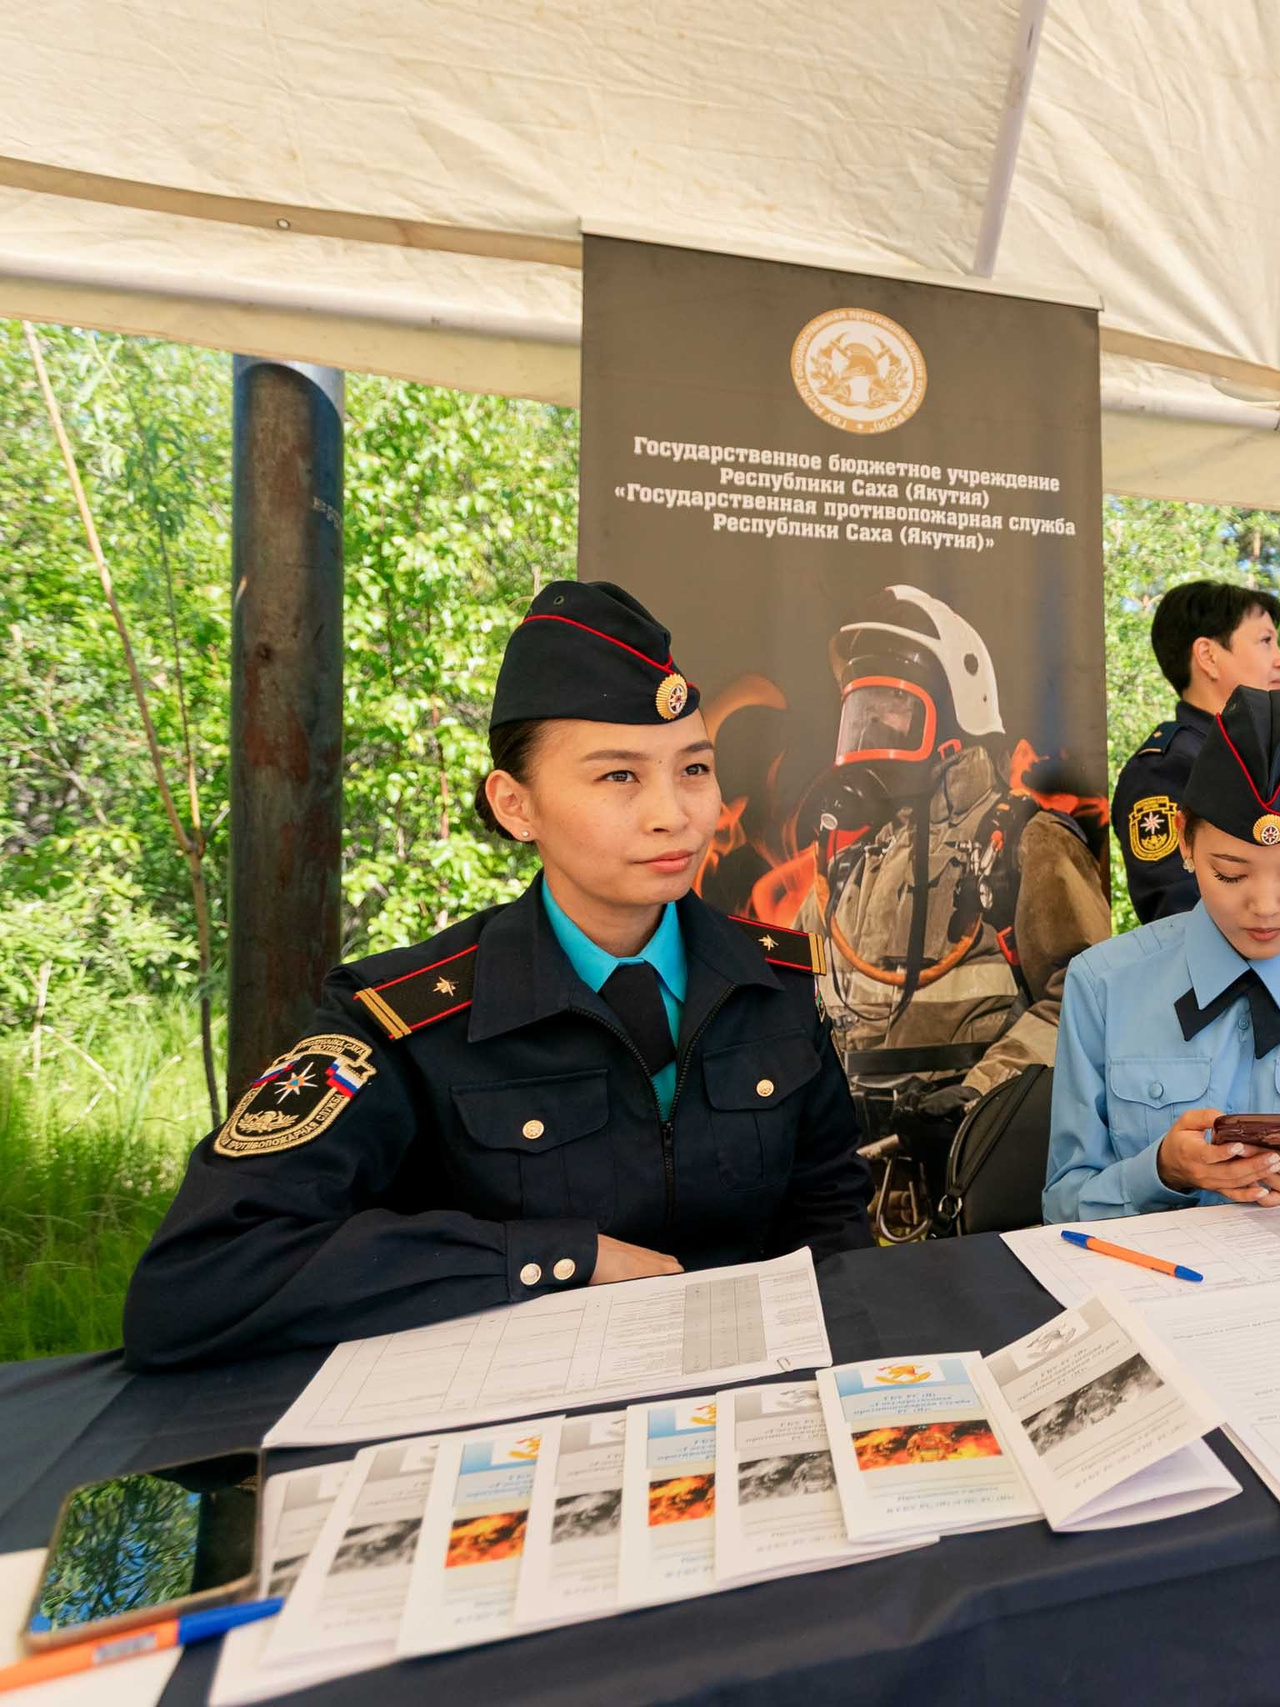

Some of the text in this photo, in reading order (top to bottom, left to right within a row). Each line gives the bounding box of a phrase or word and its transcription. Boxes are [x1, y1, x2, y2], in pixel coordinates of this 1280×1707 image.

[634, 437, 1060, 493] Государственное бюджетное учреждение
[720, 467, 989, 509] Республики Саха (Якутия)
[615, 483, 1076, 538] «Государственная противопожарная служба
[713, 514, 994, 552] Республики Саха (Якутия)»
[316, 1093, 346, 1121] СЛУЖБА
